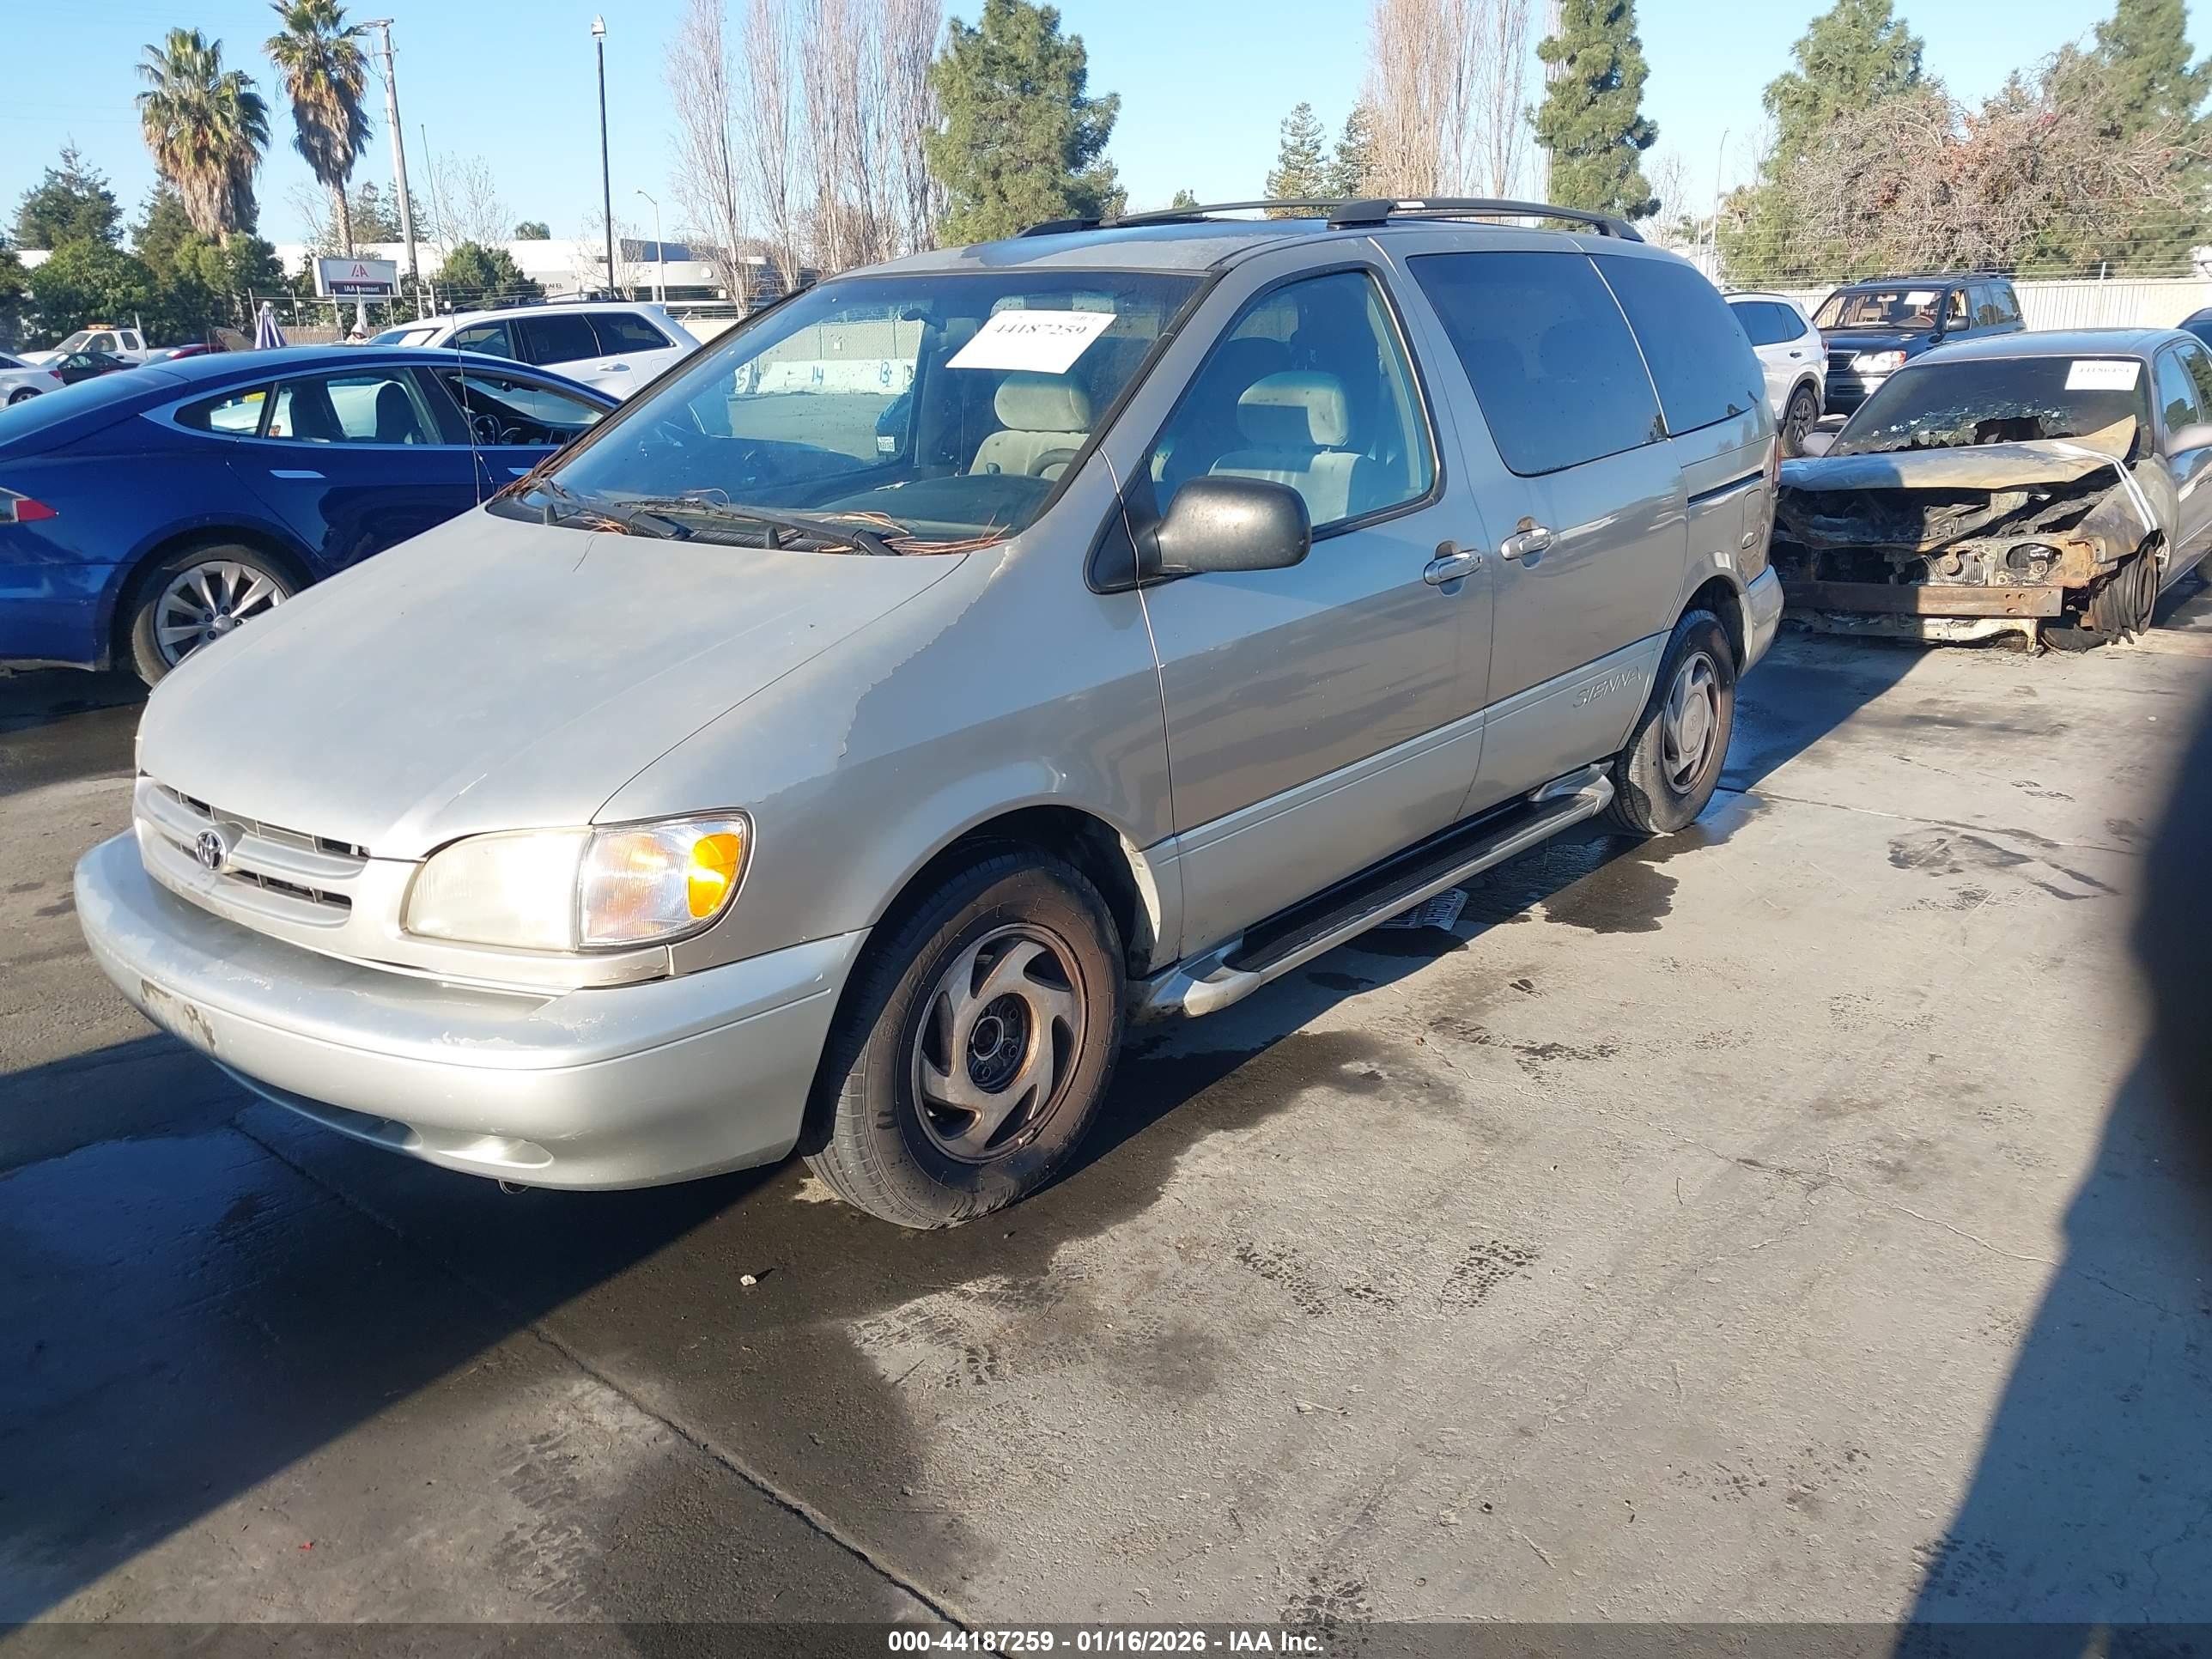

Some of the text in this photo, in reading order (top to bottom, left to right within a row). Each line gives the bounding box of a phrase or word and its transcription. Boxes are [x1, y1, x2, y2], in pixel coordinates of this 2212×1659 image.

[994, 324, 1087, 336] 44187259
[811, 365, 824, 386] 14
[1573, 665, 1641, 708] SIENNA
